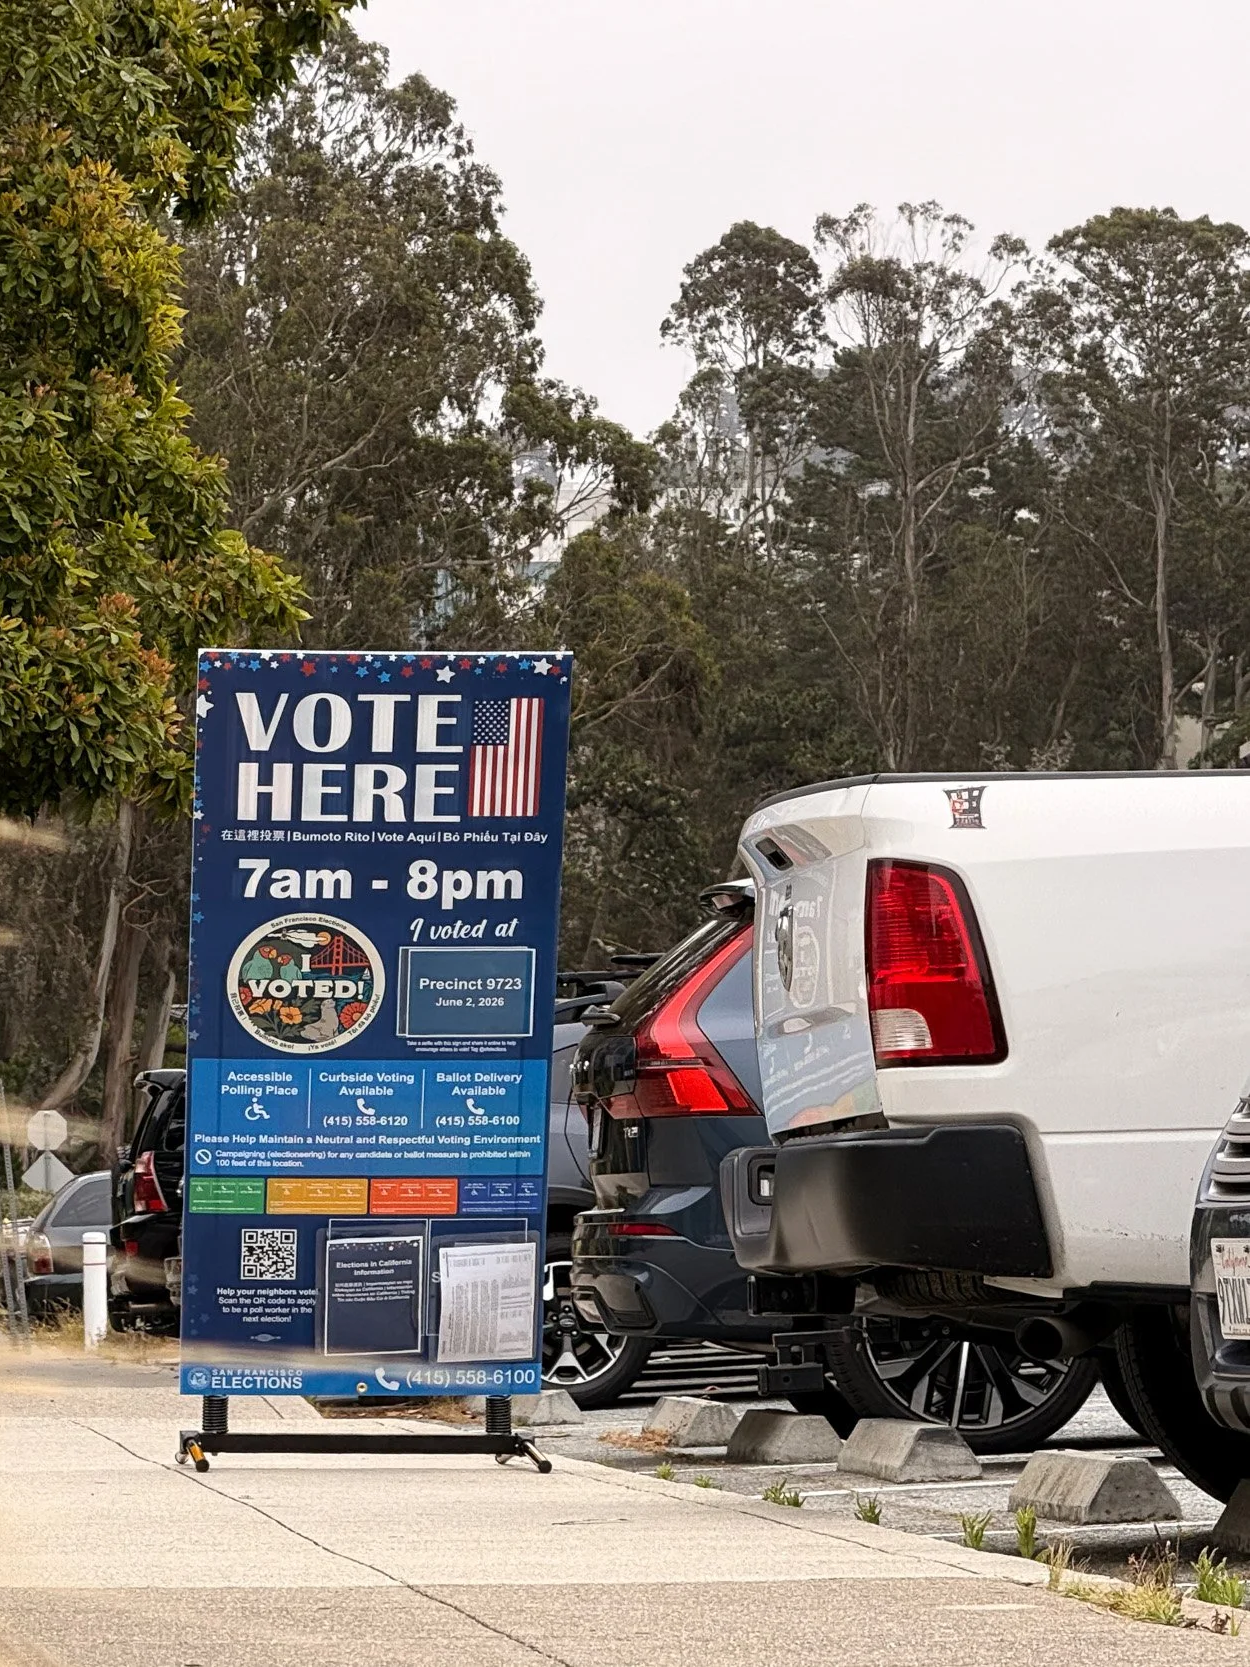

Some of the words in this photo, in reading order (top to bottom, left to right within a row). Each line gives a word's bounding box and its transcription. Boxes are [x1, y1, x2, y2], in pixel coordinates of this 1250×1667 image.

[236, 692, 464, 753] VOTE
[236, 762, 461, 823] HERE
[220, 829, 285, 842] 在這裡投票
[293, 831, 342, 842] Bumoto
[344, 831, 370, 842] Rito
[377, 832, 405, 842] Vote
[406, 832, 436, 844] Aquí
[463, 830, 499, 842] Phiếu
[502, 832, 521, 844] Tại
[524, 831, 549, 844] Đây
[238, 858, 353, 899] 7am
[406, 859, 524, 910] 8pm
[271, 920, 284, 928] San
[284, 916, 317, 924] Francisco
[318, 916, 348, 930] Elections
[410, 918, 424, 942] I
[430, 919, 488, 940] voted
[494, 918, 519, 938] at
[300, 953, 312, 972] I
[248, 979, 365, 1000] VOTED!
[419, 978, 483, 990] Precinct
[486, 978, 522, 990] 9723
[435, 997, 463, 1006] June
[465, 997, 476, 1008] 2,
[478, 997, 505, 1006] 2026
[227, 1071, 293, 1082] Accessible
[319, 1072, 373, 1083] Curbside
[376, 1072, 415, 1084] Voting
[436, 1072, 472, 1082] Ballot
[474, 1072, 522, 1084] Delivery
[221, 1085, 263, 1097] Polling
[266, 1085, 299, 1095] Place
[339, 1086, 394, 1096] Available
[451, 1086, 506, 1096] Available
[323, 1115, 353, 1128] (415)
[355, 1116, 408, 1126] 558-6120
[435, 1115, 465, 1128] (415)
[467, 1116, 520, 1126] 558-6100
[194, 1134, 230, 1143] Please
[232, 1134, 256, 1145] Help
[259, 1134, 304, 1144] Maintain
[306, 1136, 313, 1144] a
[315, 1135, 353, 1144] Neutral
[356, 1135, 376, 1144] and
[378, 1135, 435, 1146] Respectful
[437, 1135, 471, 1146] Voting
[473, 1134, 541, 1144] Environment
[215, 1150, 266, 1159] Campaigning
[267, 1150, 326, 1160] (electioneering)
[339, 1152, 354, 1160] any
[355, 1151, 393, 1159] candidate
[404, 1151, 425, 1159] ballot
[469, 1151, 507, 1160] prohibited
[216, 1159, 230, 1167] 100
[231, 1159, 247, 1167] feet
[248, 1159, 256, 1167] of
[257, 1159, 271, 1167] this
[336, 1261, 369, 1269] Elections
[378, 1258, 413, 1267] California
[353, 1268, 395, 1276] Information
[216, 1287, 235, 1296] Help
[236, 1288, 255, 1297] your
[257, 1288, 297, 1297] neighbors
[296, 1298, 317, 1306] apply
[249, 1306, 263, 1314] poll
[260, 1315, 292, 1323] election!
[211, 1376, 303, 1389] ELECTIONS
[406, 1370, 451, 1388] (415)
[455, 1369, 535, 1385] 558-6100
